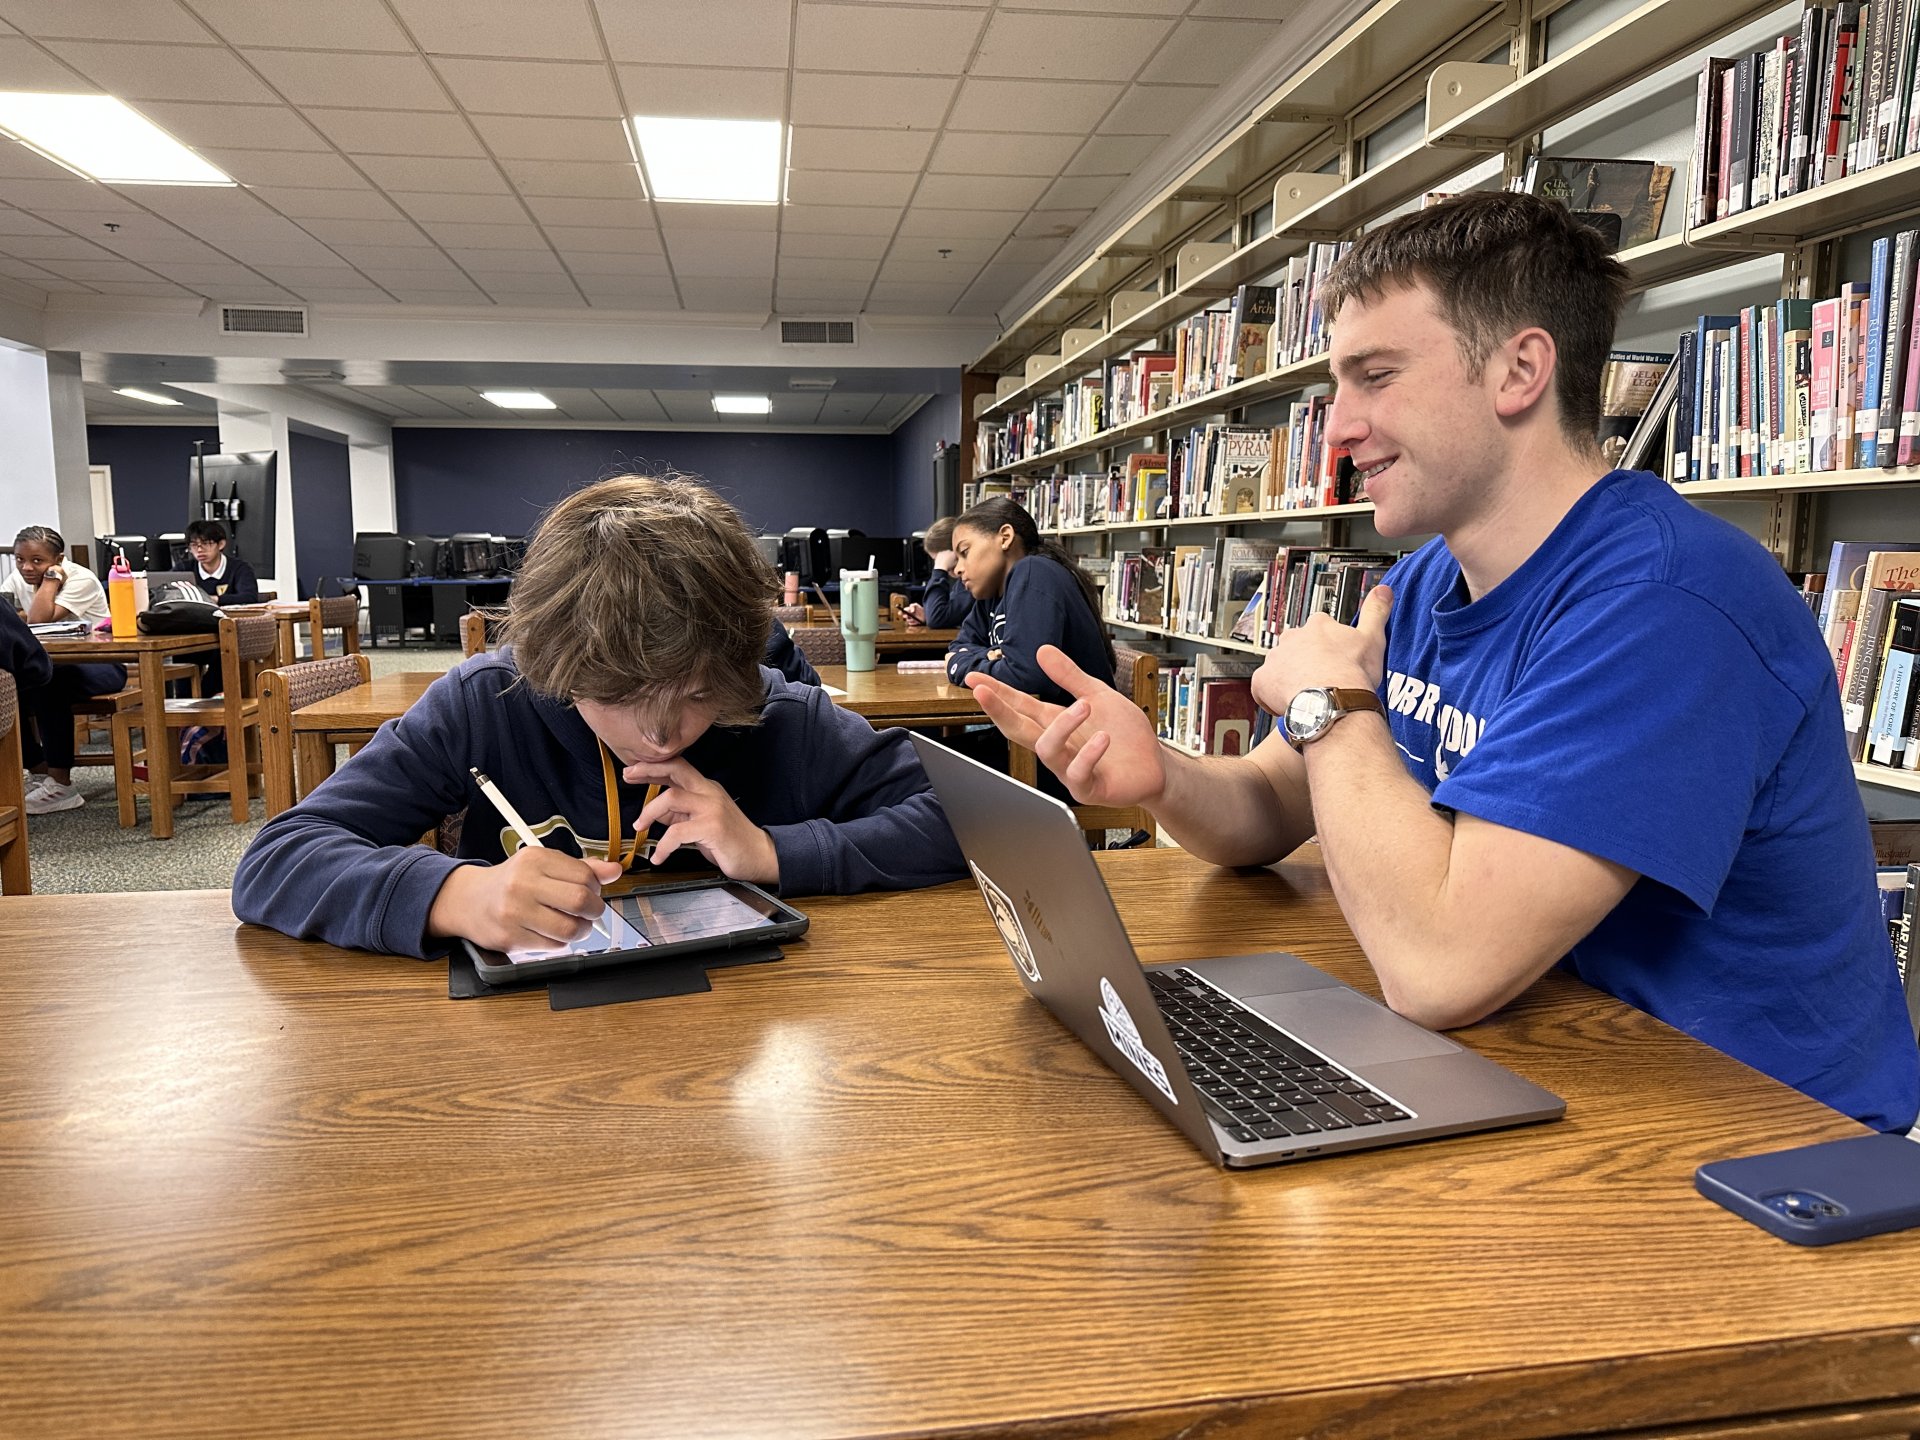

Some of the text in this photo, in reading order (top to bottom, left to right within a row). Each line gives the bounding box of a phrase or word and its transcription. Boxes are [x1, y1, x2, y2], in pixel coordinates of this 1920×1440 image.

[1875, 13, 1884, 36] Mind
[1891, 16, 1901, 48] GARDEN
[1874, 38, 1880, 46] of
[1890, 52, 1897, 62] OF
[1869, 51, 1883, 100] ADOLF
[1886, 64, 1895, 92] BEASTS
[1541, 182, 1576, 197] Secret
[1554, 178, 1568, 188] The
[1882, 246, 1902, 396] SALISBURY RUSSIA IN REVOLUTION
[1867, 318, 1878, 368] RUSSIA
[1632, 370, 1665, 379] DELAY
[1742, 381, 1748, 392] OF
[1886, 566, 1919, 581] The
[1859, 603, 1873, 650] EMPRESS
[1855, 634, 1876, 706] JUNG CHANG
[1893, 670, 1903, 701] HISTORY
[1891, 702, 1897, 712] OF
[1886, 713, 1894, 738] KOREA
[1903, 912, 1912, 942] WAR
[1900, 943, 1907, 959] IN
